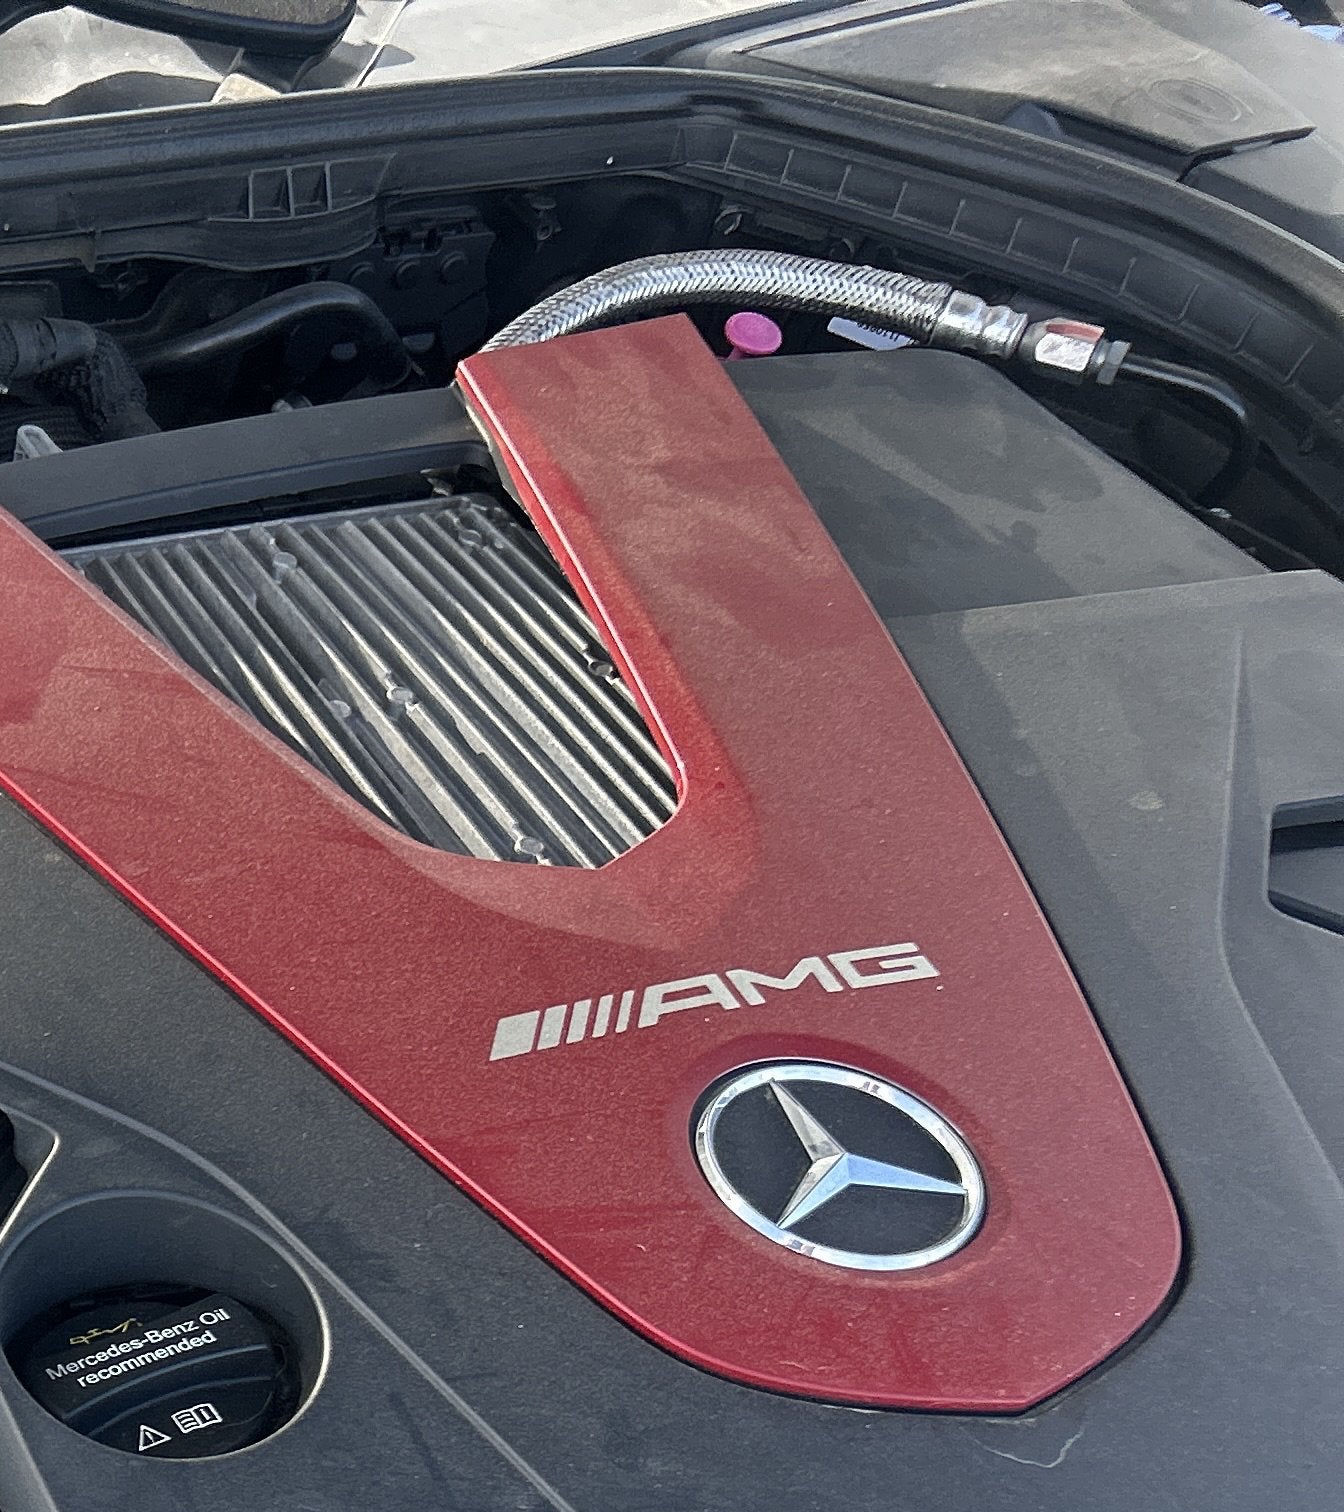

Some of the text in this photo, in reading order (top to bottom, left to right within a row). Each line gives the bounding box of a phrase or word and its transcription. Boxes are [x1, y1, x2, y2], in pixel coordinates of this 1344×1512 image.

[638, 942, 940, 1028] AMG
[45, 1308, 231, 1381] Mercedes-Benz Oil
[77, 1330, 218, 1388] recommended
